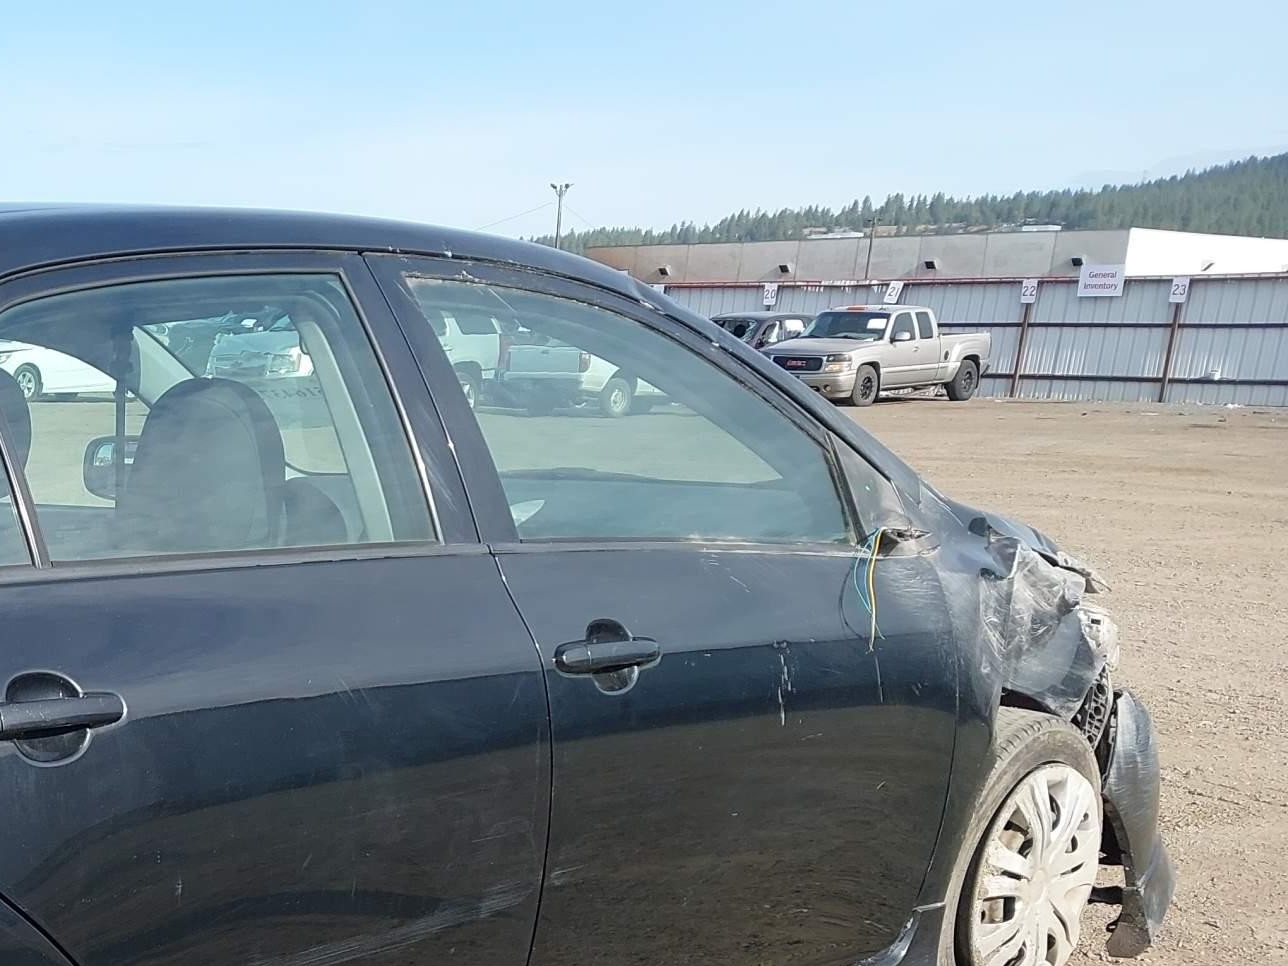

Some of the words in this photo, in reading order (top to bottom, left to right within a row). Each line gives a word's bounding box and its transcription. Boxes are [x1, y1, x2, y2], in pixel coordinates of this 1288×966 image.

[1088, 271, 1117, 279] General
[888, 286, 900, 297] 21
[1022, 285, 1036, 297] 22
[1083, 282, 1119, 291] Inventory
[1172, 284, 1187, 296] 23
[764, 289, 776, 300] 20
